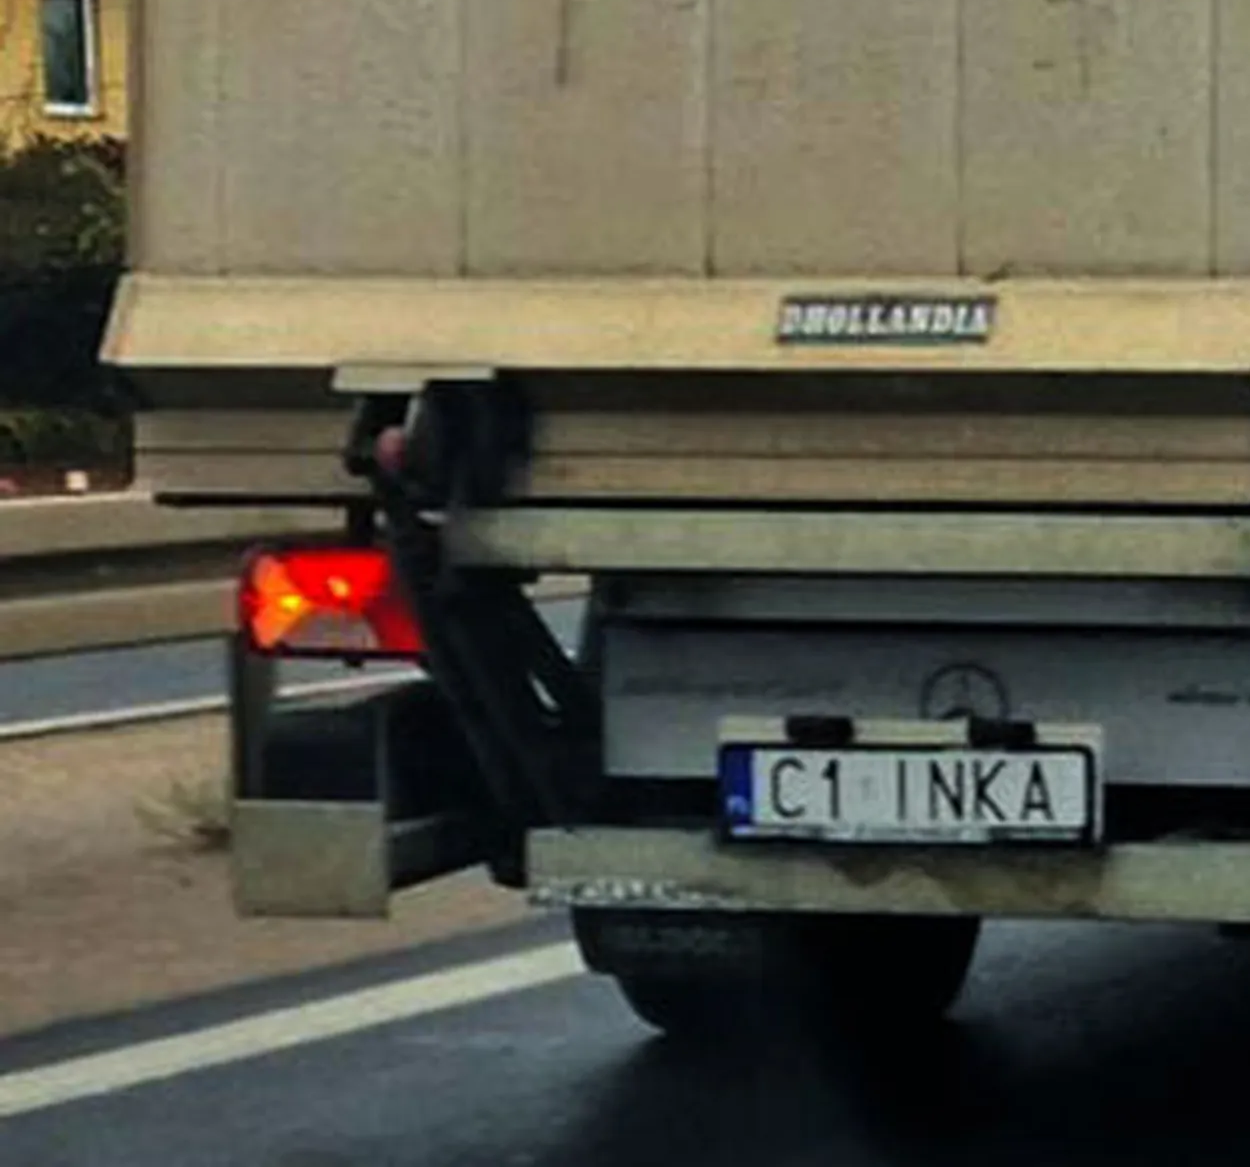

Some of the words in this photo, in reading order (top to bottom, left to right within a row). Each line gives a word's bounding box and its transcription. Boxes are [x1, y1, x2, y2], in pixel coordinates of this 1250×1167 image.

[780, 303, 990, 336] DHOLLANDIA
[769, 755, 840, 820] C1
[896, 757, 1055, 822] INKA
